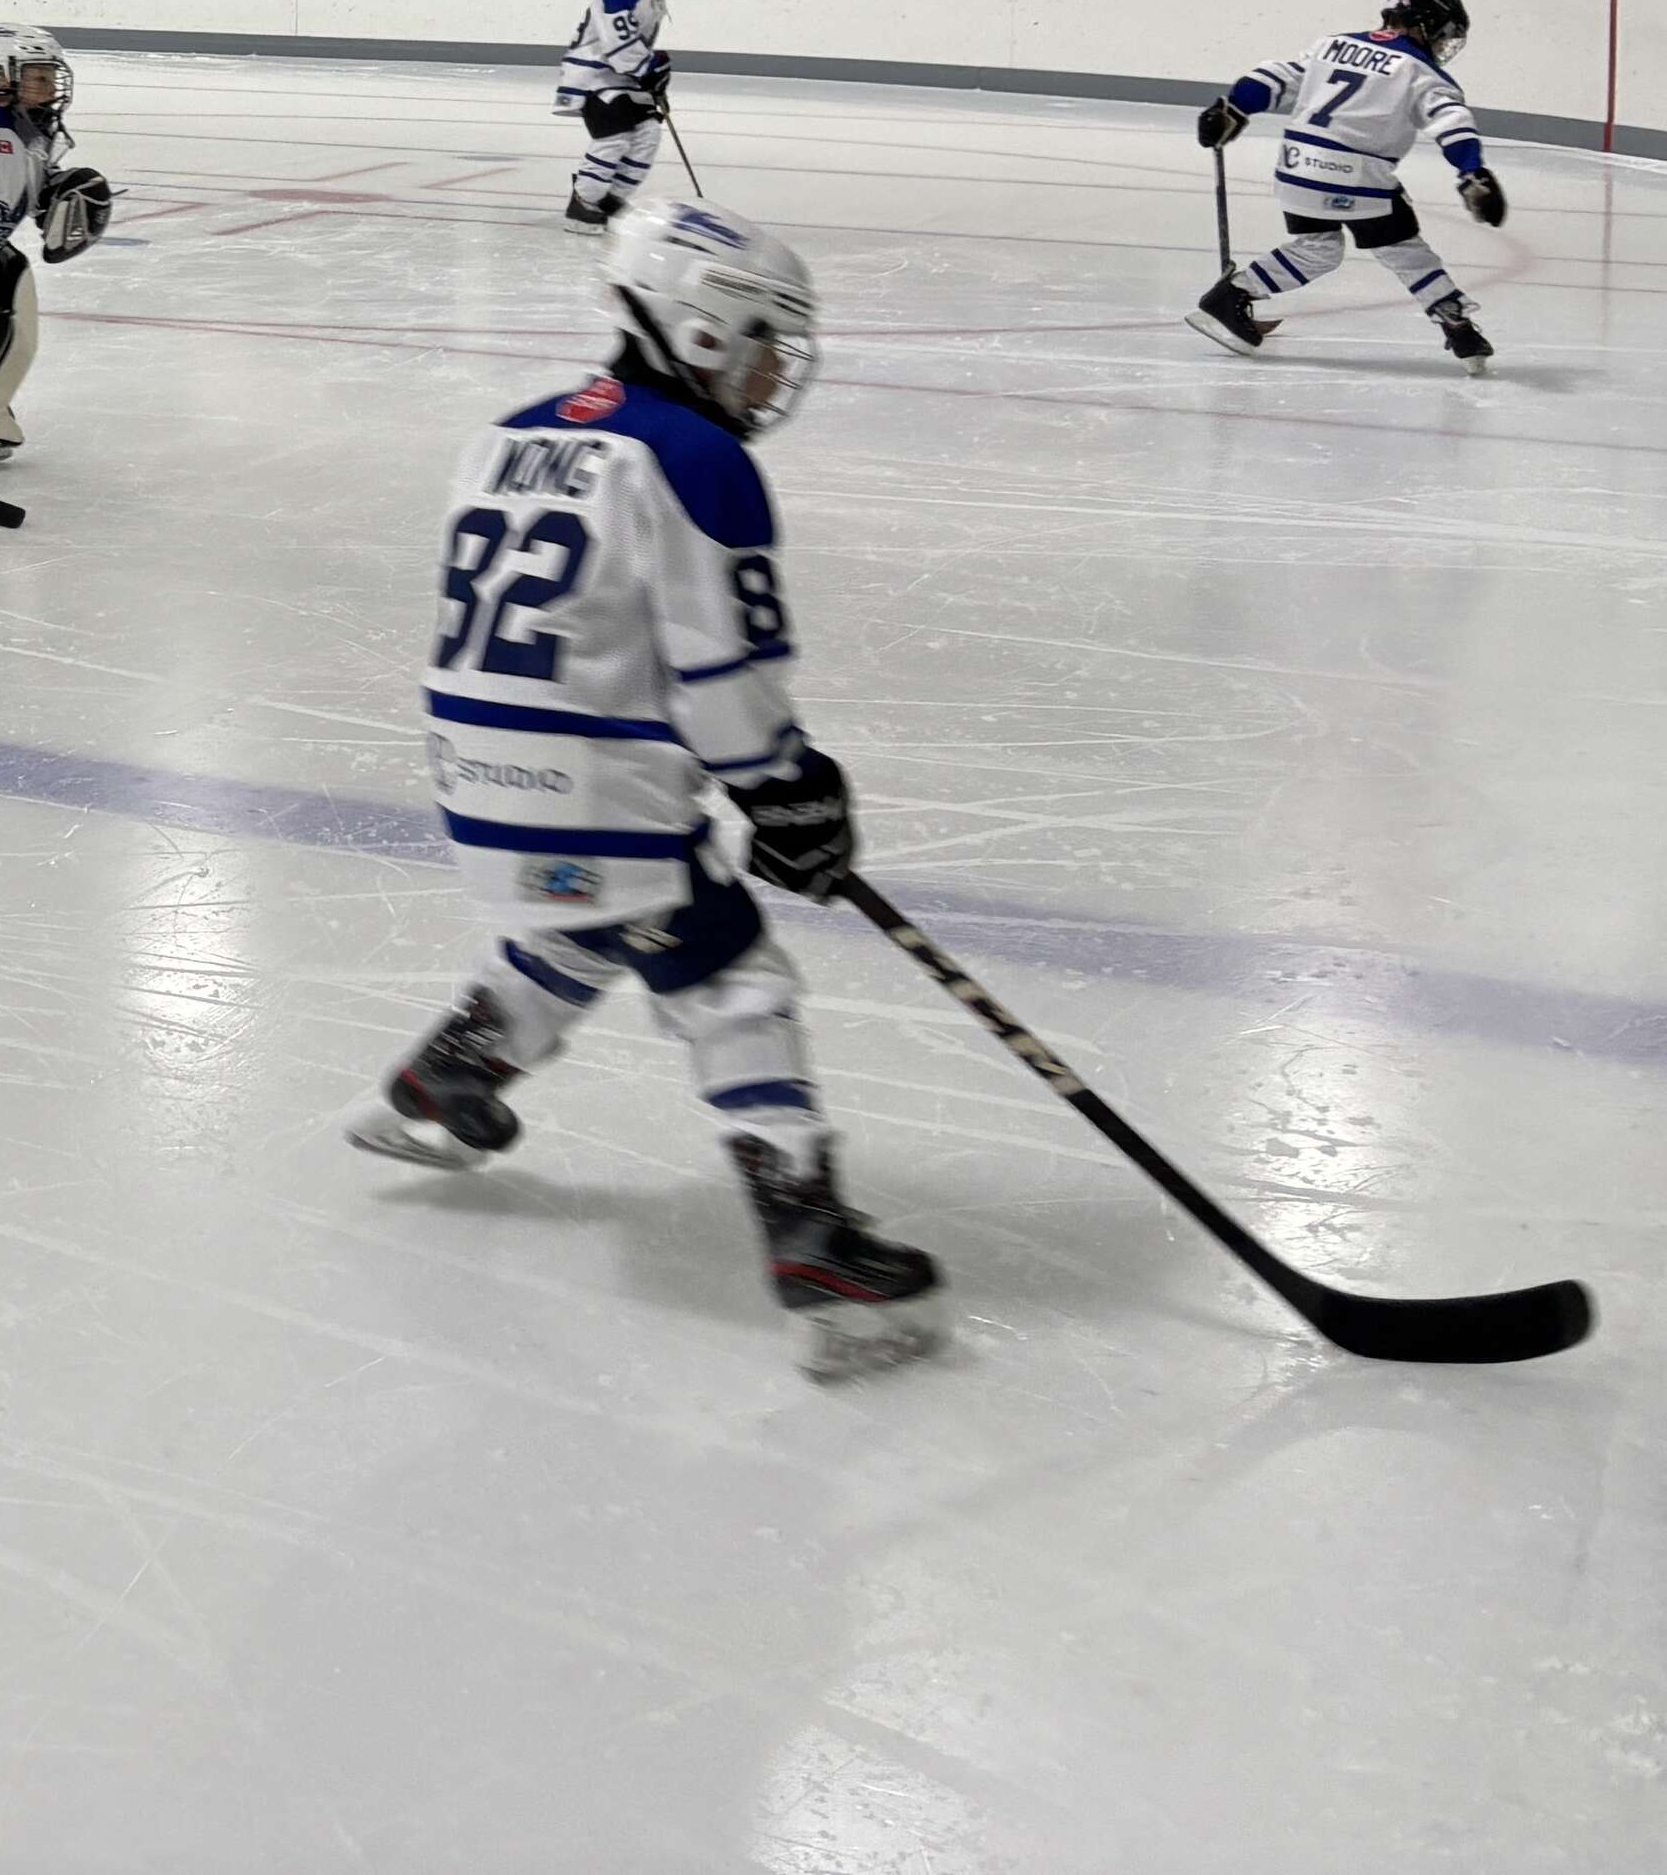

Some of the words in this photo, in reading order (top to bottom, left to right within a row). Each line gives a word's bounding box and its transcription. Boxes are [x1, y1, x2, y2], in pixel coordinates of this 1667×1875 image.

[1322, 39, 1402, 75] MOORE
[1308, 69, 1368, 128] 7
[1305, 157, 1354, 174] STUDIO
